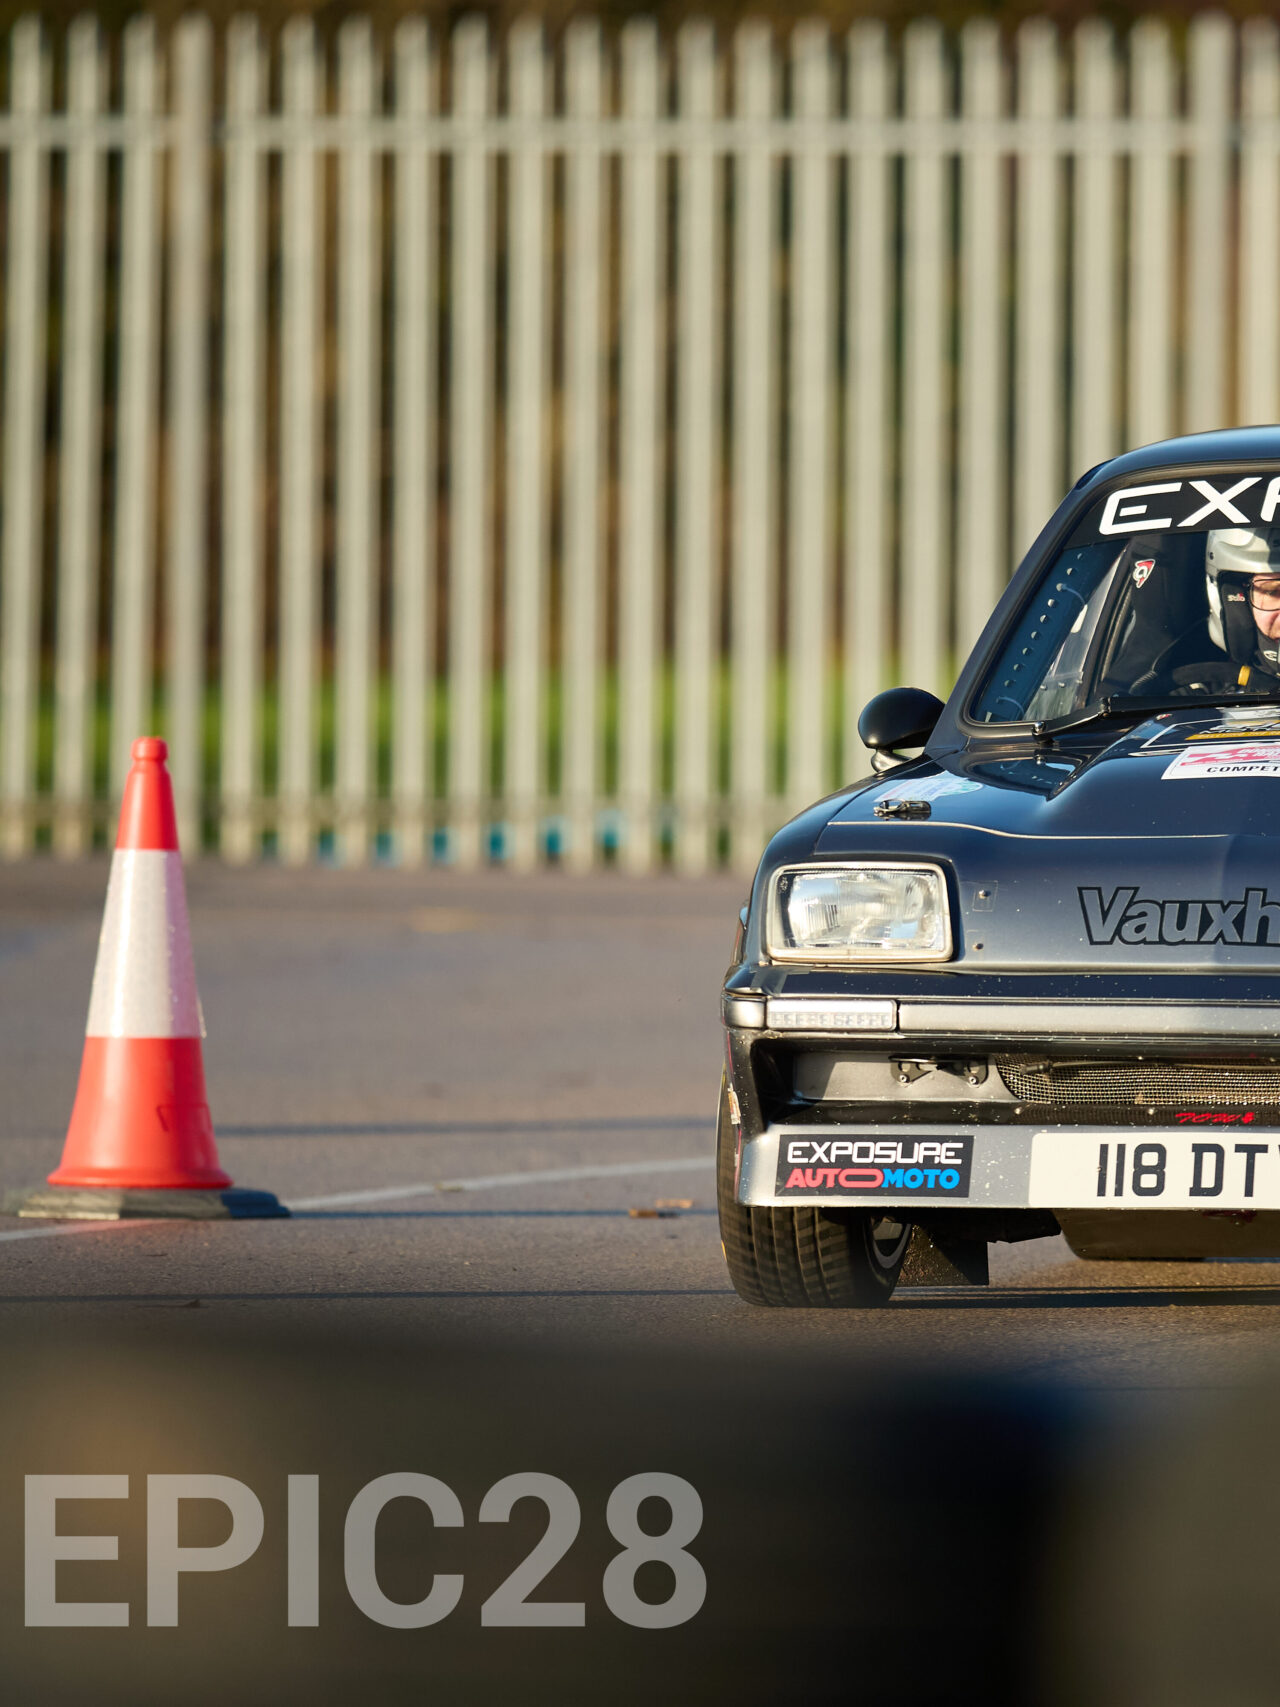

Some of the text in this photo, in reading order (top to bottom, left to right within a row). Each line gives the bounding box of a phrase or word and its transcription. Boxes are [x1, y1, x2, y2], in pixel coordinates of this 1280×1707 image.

[787, 1141, 964, 1165] EXPOSURE
[785, 1167, 960, 1189] AUTOMOTO
[1096, 1142, 1167, 1198] 118
